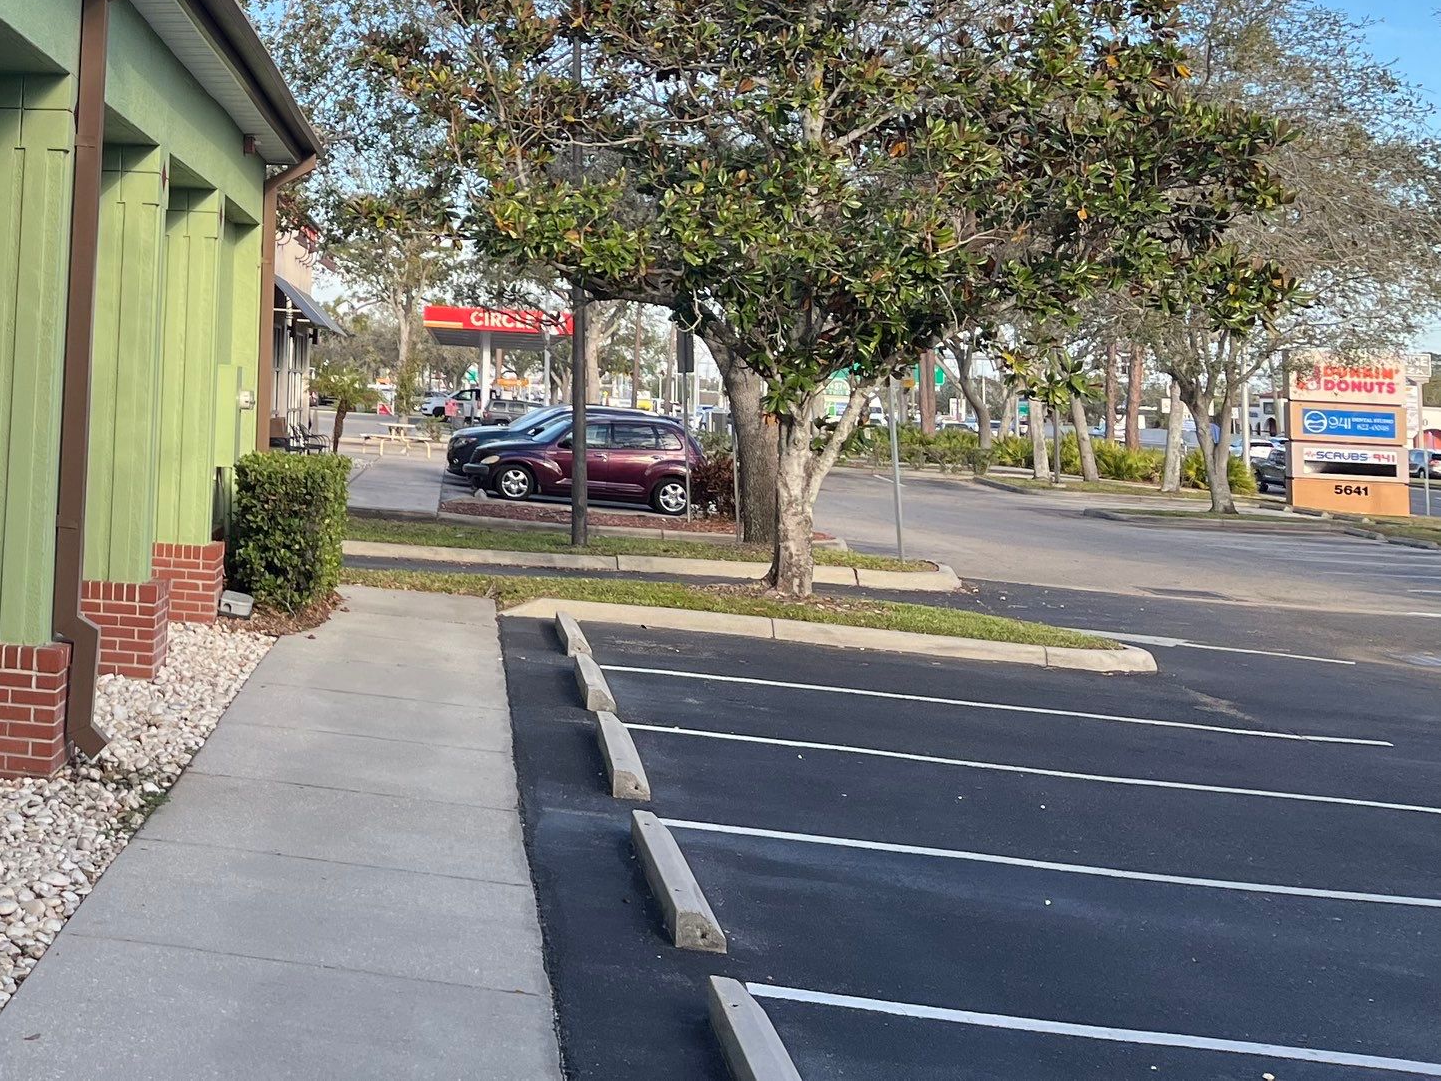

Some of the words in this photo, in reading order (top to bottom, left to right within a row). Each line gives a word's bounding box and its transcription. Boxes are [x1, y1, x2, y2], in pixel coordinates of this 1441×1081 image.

[470, 311, 537, 330] CIRCLE
[1323, 379, 1397, 394] DONUTS
[1328, 416, 1352, 430] 941
[1316, 450, 1369, 462] SCRUBS
[1372, 453, 1396, 463] 941
[1334, 484, 1369, 497] 5641
